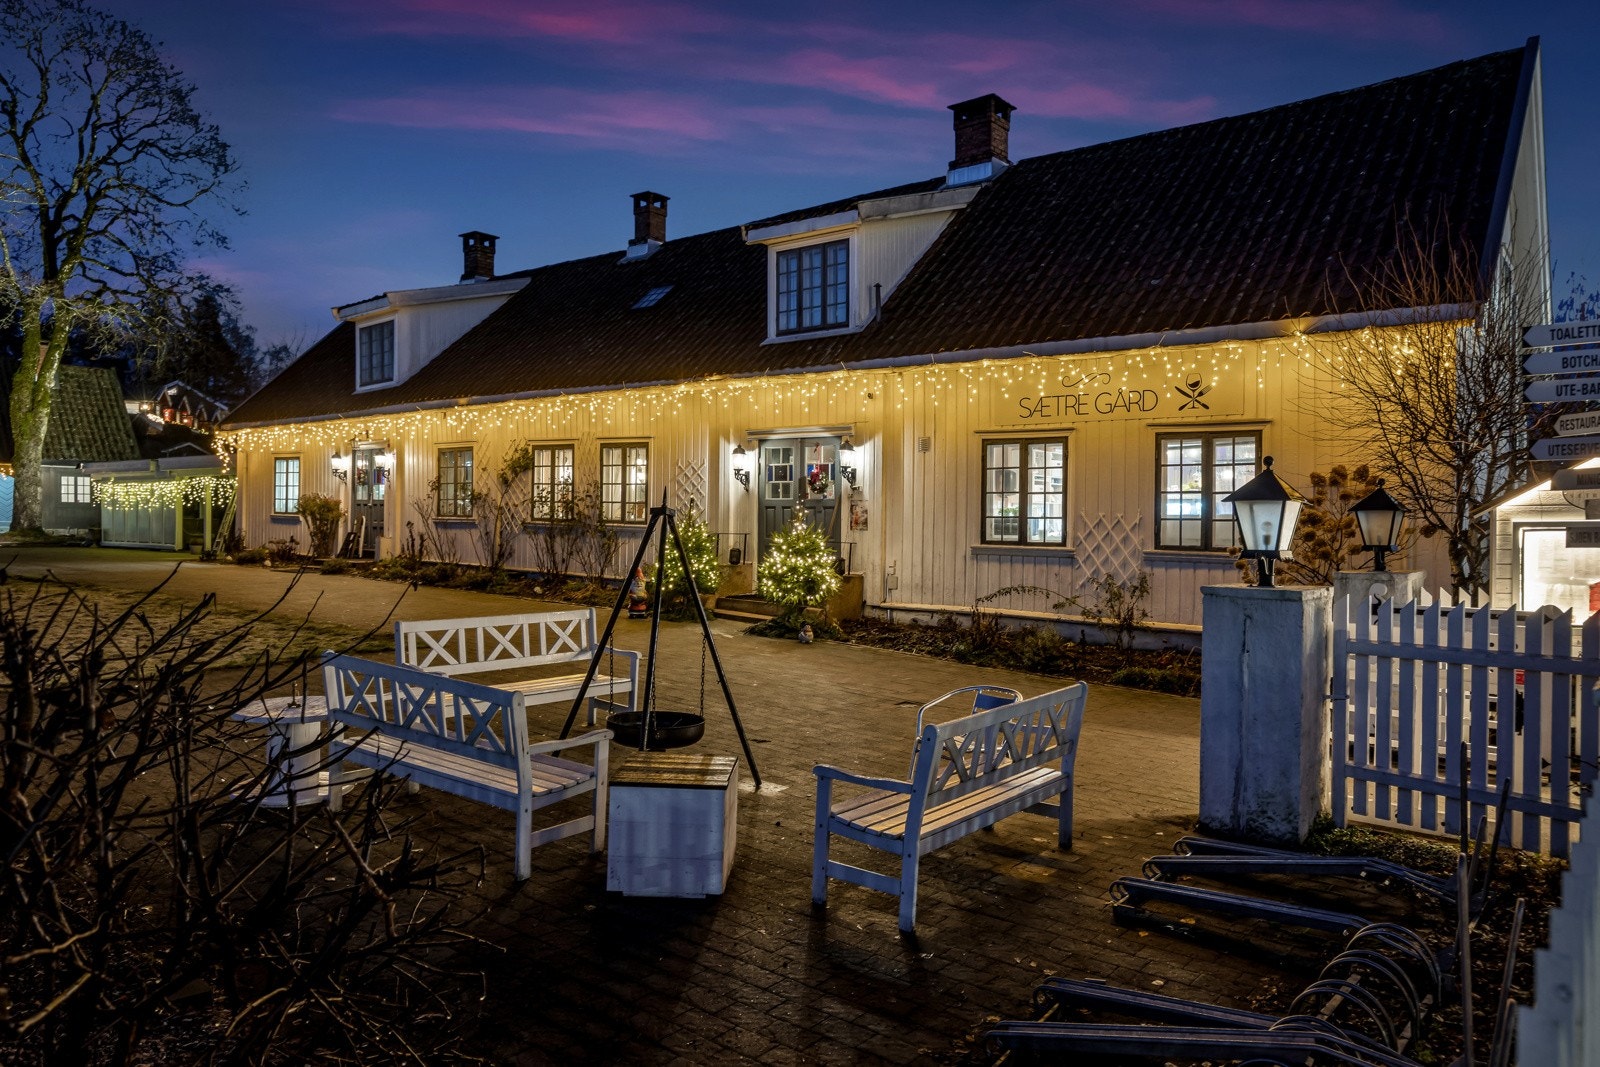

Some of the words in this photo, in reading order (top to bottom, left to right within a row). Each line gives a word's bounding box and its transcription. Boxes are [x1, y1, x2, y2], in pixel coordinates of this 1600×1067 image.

[1562, 354, 1600, 369] BOTCH
[1019, 393, 1089, 418] SÆTRE
[1094, 388, 1159, 414] GÅRD
